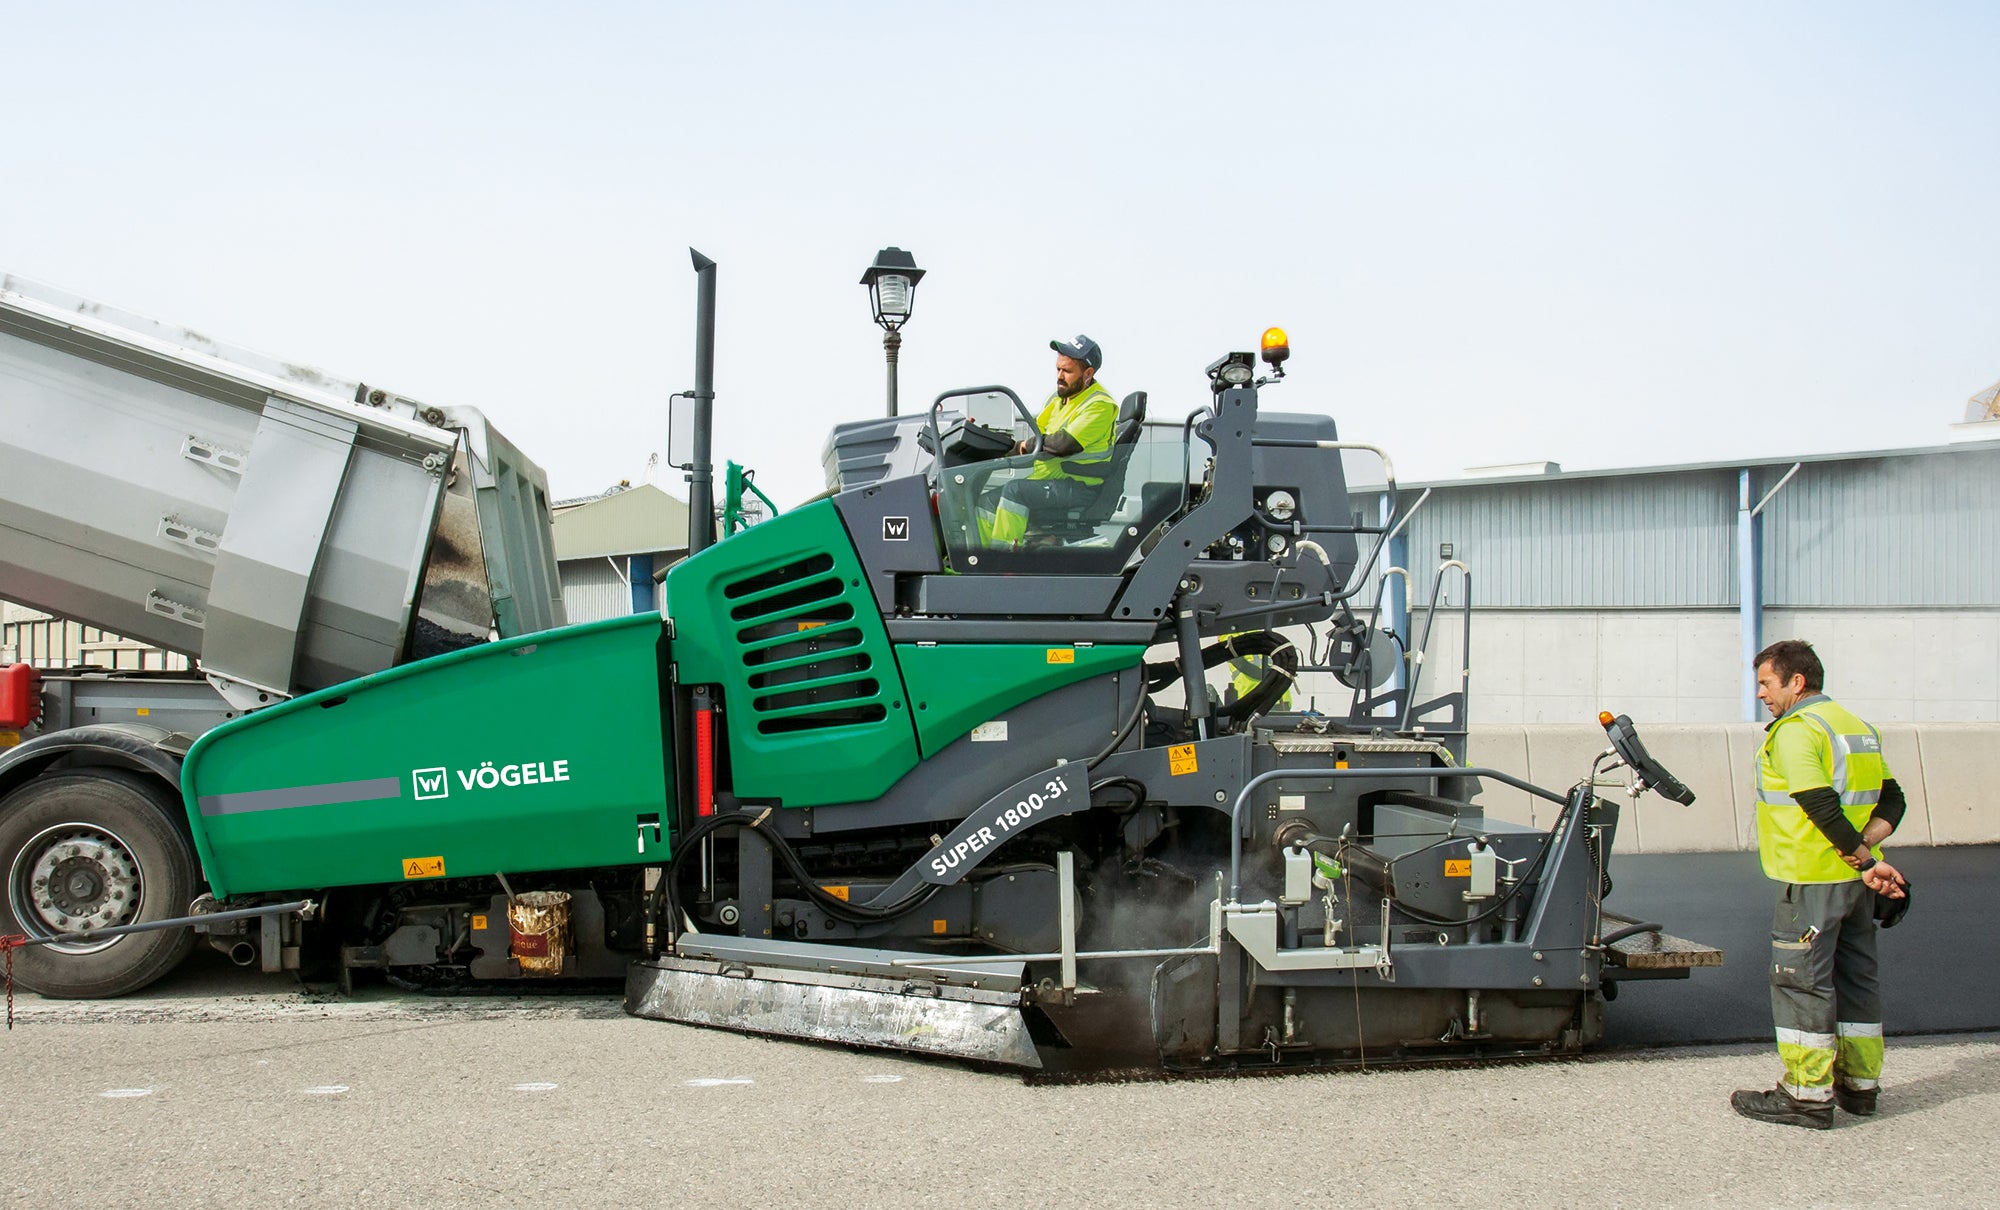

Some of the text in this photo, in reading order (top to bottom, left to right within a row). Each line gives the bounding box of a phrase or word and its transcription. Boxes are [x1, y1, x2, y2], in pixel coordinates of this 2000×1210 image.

[456, 760, 570, 791] VÖGELE
[931, 776, 1068, 877] SUPER 1800-3i
